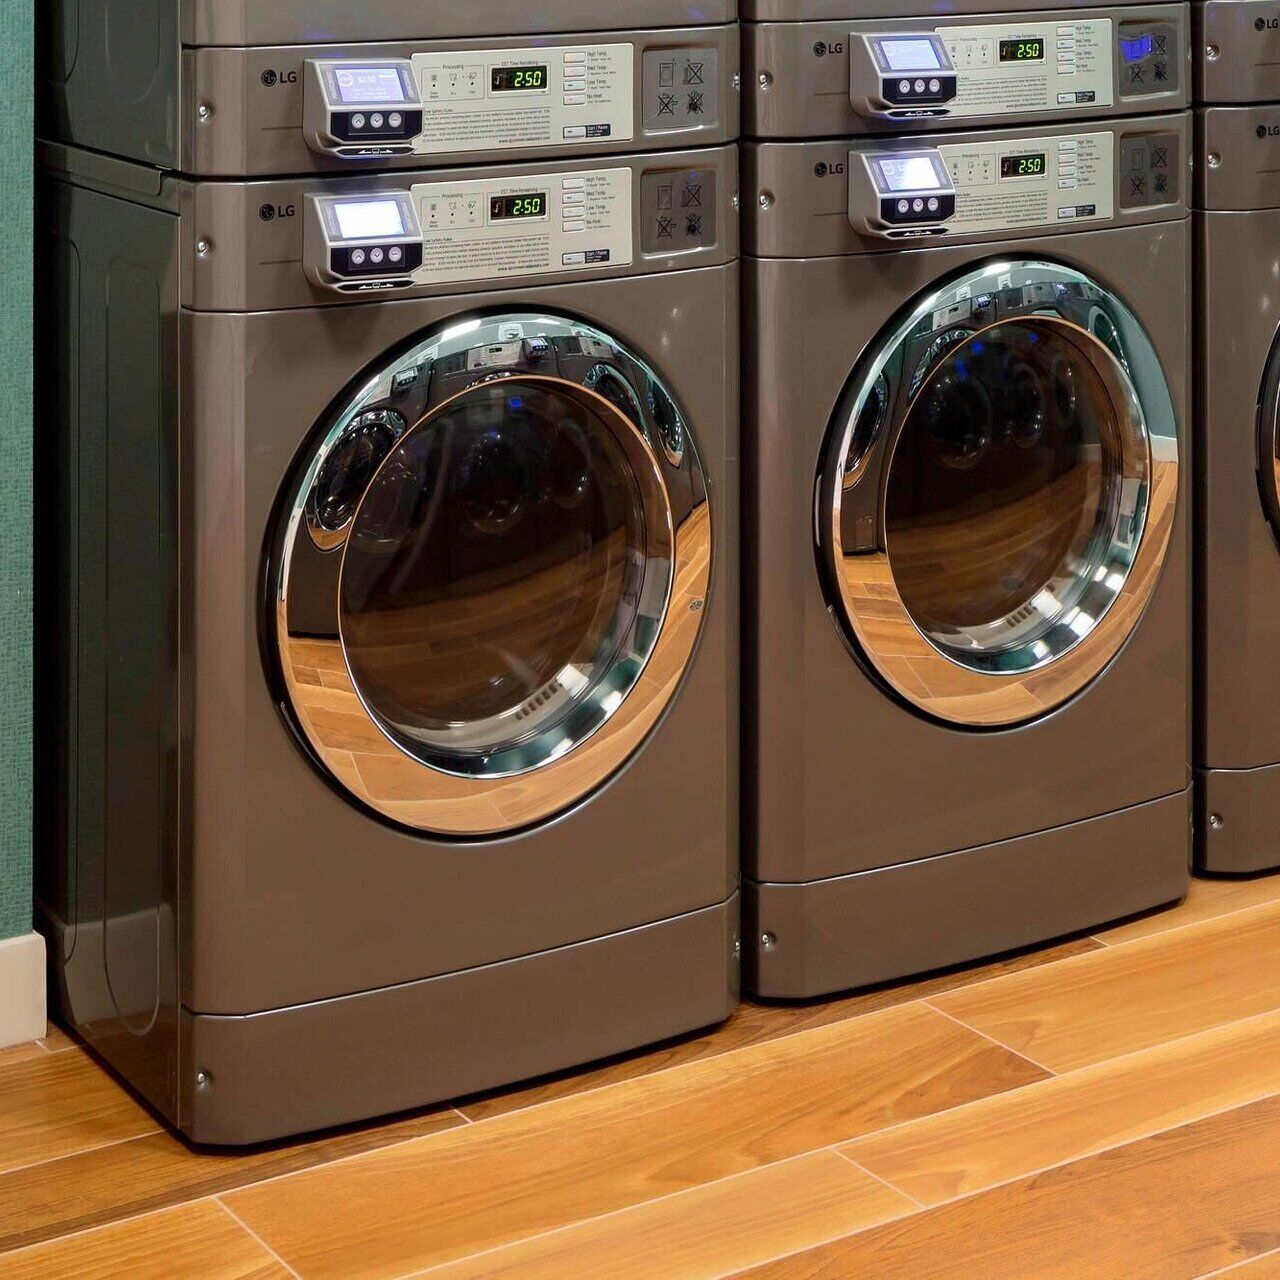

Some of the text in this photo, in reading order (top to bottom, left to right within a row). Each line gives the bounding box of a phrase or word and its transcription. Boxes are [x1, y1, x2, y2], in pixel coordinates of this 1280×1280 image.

[1267, 19, 1278, 29] LG
[828, 43, 842, 54] LG
[1017, 43, 1039, 58] 2.50
[280, 71, 297, 84] LG
[514, 71, 541, 87] 2.50
[1268, 126, 1280, 135] LG
[829, 163, 843, 174] LG
[1019, 158, 1041, 173] 2.50
[278, 205, 295, 218] LG
[513, 198, 540, 215] 2.50
